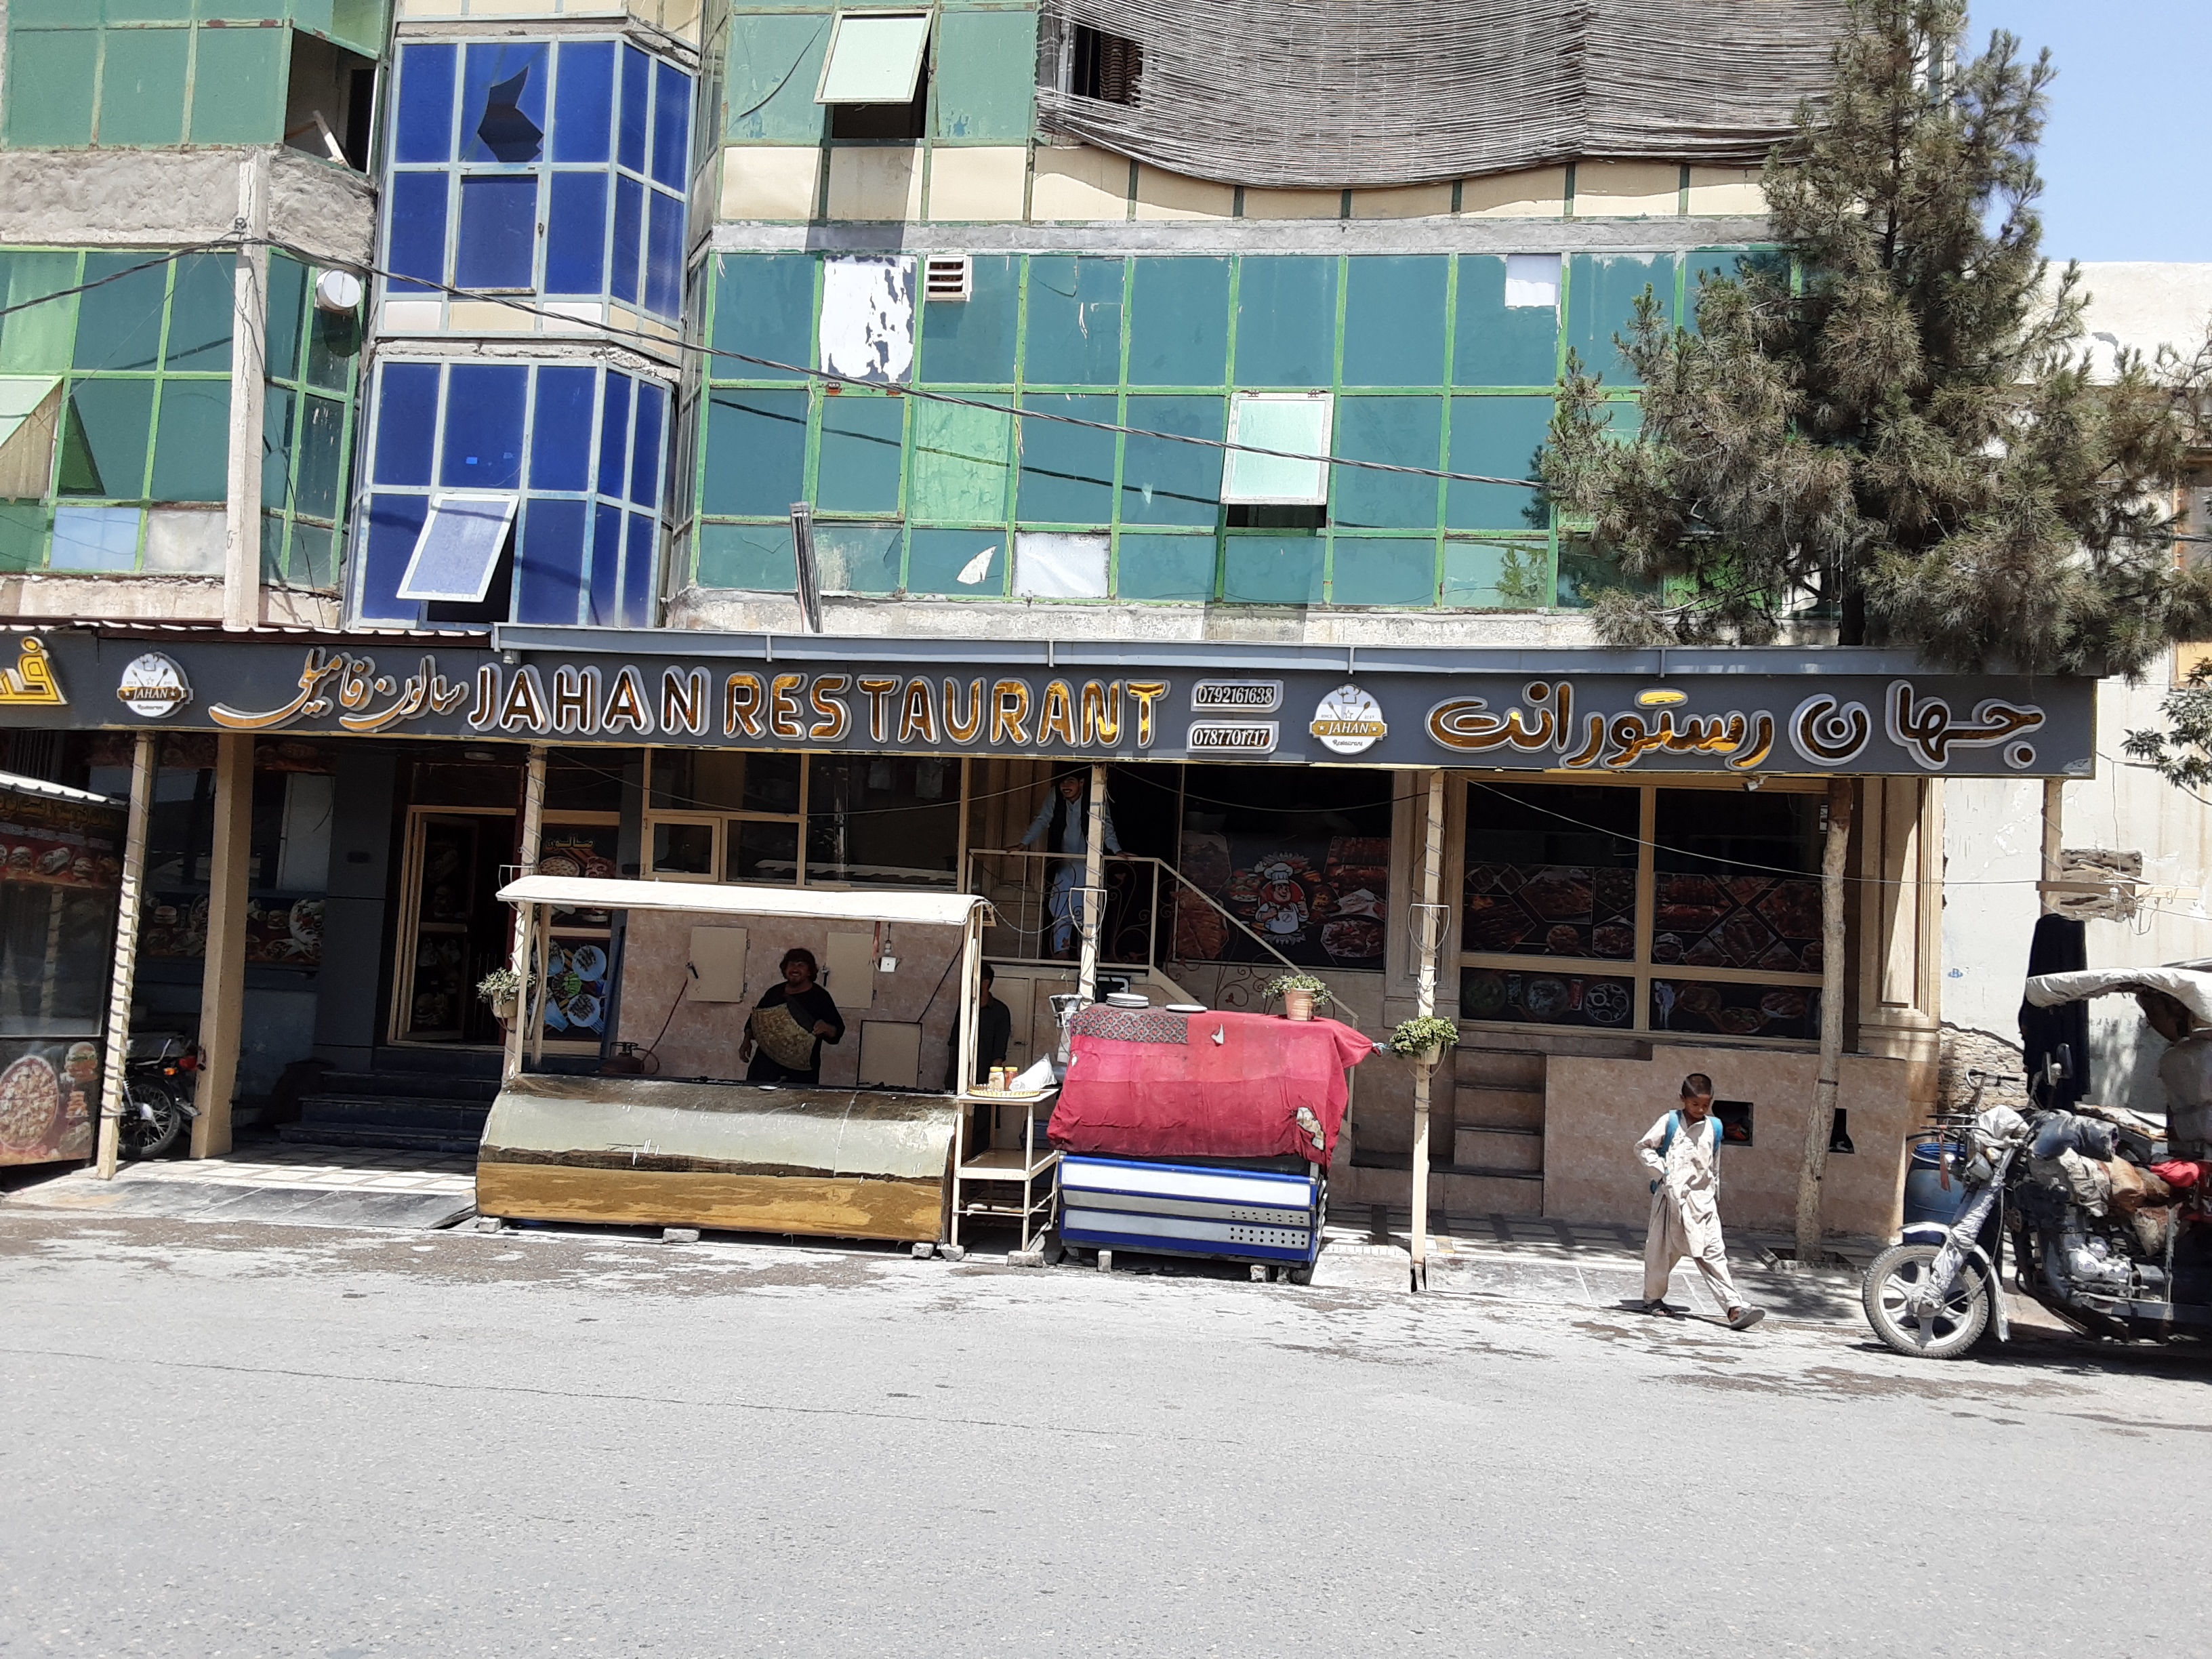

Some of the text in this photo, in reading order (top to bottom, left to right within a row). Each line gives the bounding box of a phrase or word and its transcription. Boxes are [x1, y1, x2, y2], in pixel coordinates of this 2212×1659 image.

[133, 688, 169, 700] JAHAN
[338, 656, 469, 732] سالون
[1197, 687, 1273, 703] 0792161638
[468, 663, 1168, 747] JAHAN RESTAURANT
[1328, 722, 1370, 735] JAHAN
[1426, 678, 2046, 770] جهان رستورانت
[1193, 729, 1268, 745] 0787701717
